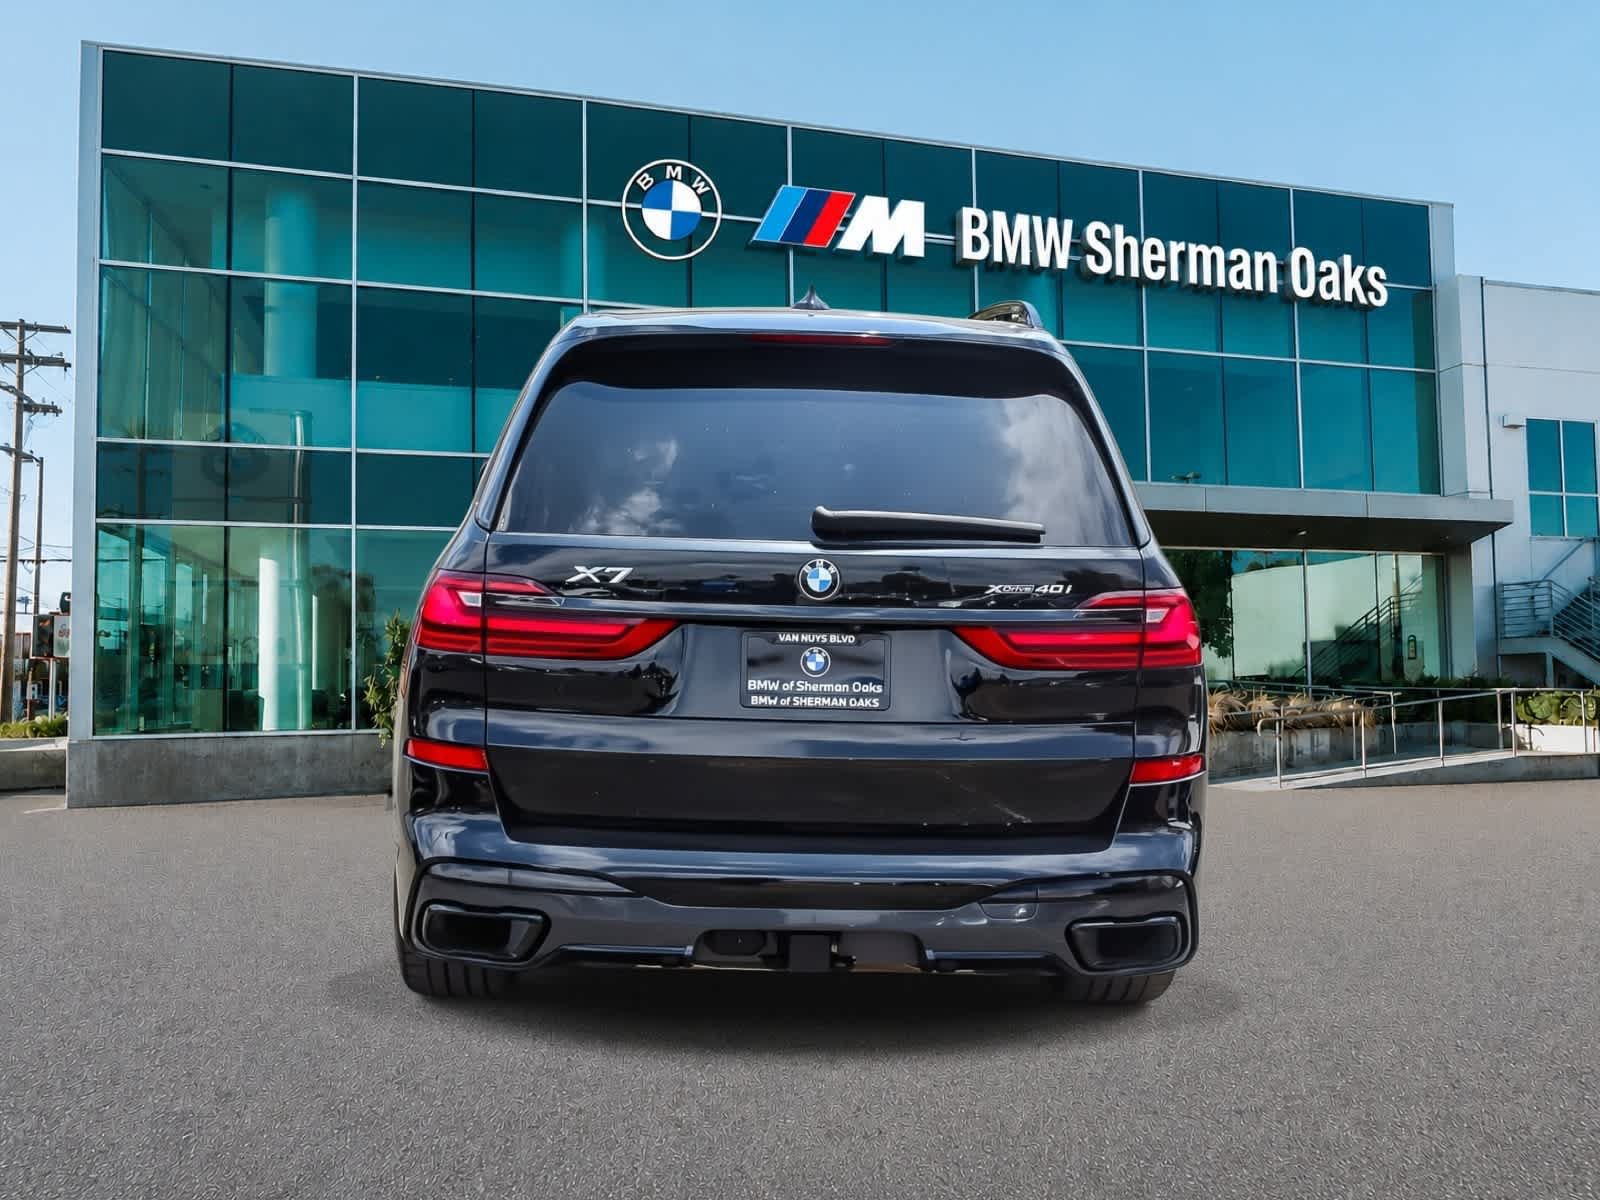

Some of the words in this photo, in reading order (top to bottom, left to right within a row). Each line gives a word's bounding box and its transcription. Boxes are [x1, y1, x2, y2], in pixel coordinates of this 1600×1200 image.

[635, 164, 712, 196] BMW
[960, 206, 1073, 270] BMW
[1084, 220, 1278, 294] Sherman
[1288, 247, 1390, 308] Oaks
[565, 565, 633, 584] X7
[778, 633, 799, 642] VAN
[800, 633, 827, 643] NUYS
[829, 634, 856, 644] BLVD
[747, 679, 780, 691] BMW
[782, 681, 795, 692] of
[796, 680, 849, 692] Sherman
[852, 682, 883, 693] Oaks
[751, 695, 778, 705] BMW
[780, 696, 792, 706] of
[792, 697, 847, 707] SHERMAN
[849, 698, 880, 708] OAKS
